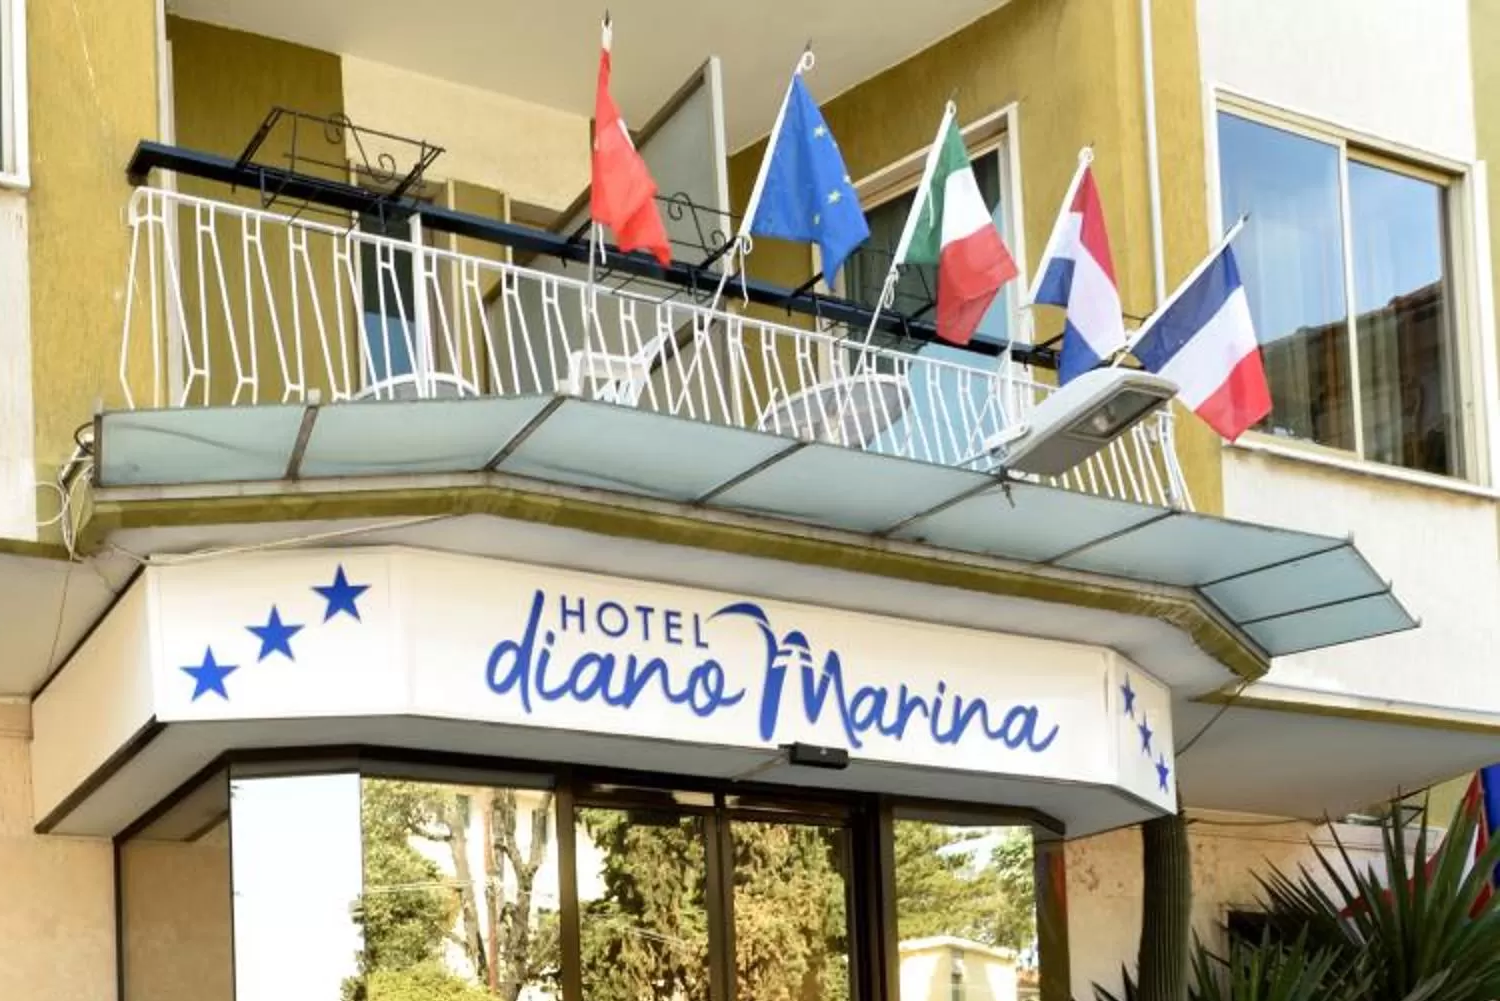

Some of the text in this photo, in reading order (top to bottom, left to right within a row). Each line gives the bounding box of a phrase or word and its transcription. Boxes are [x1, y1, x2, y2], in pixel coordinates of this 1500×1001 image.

[486, 588, 1060, 752] diano Marina
[559, 595, 709, 649] HOTEL
